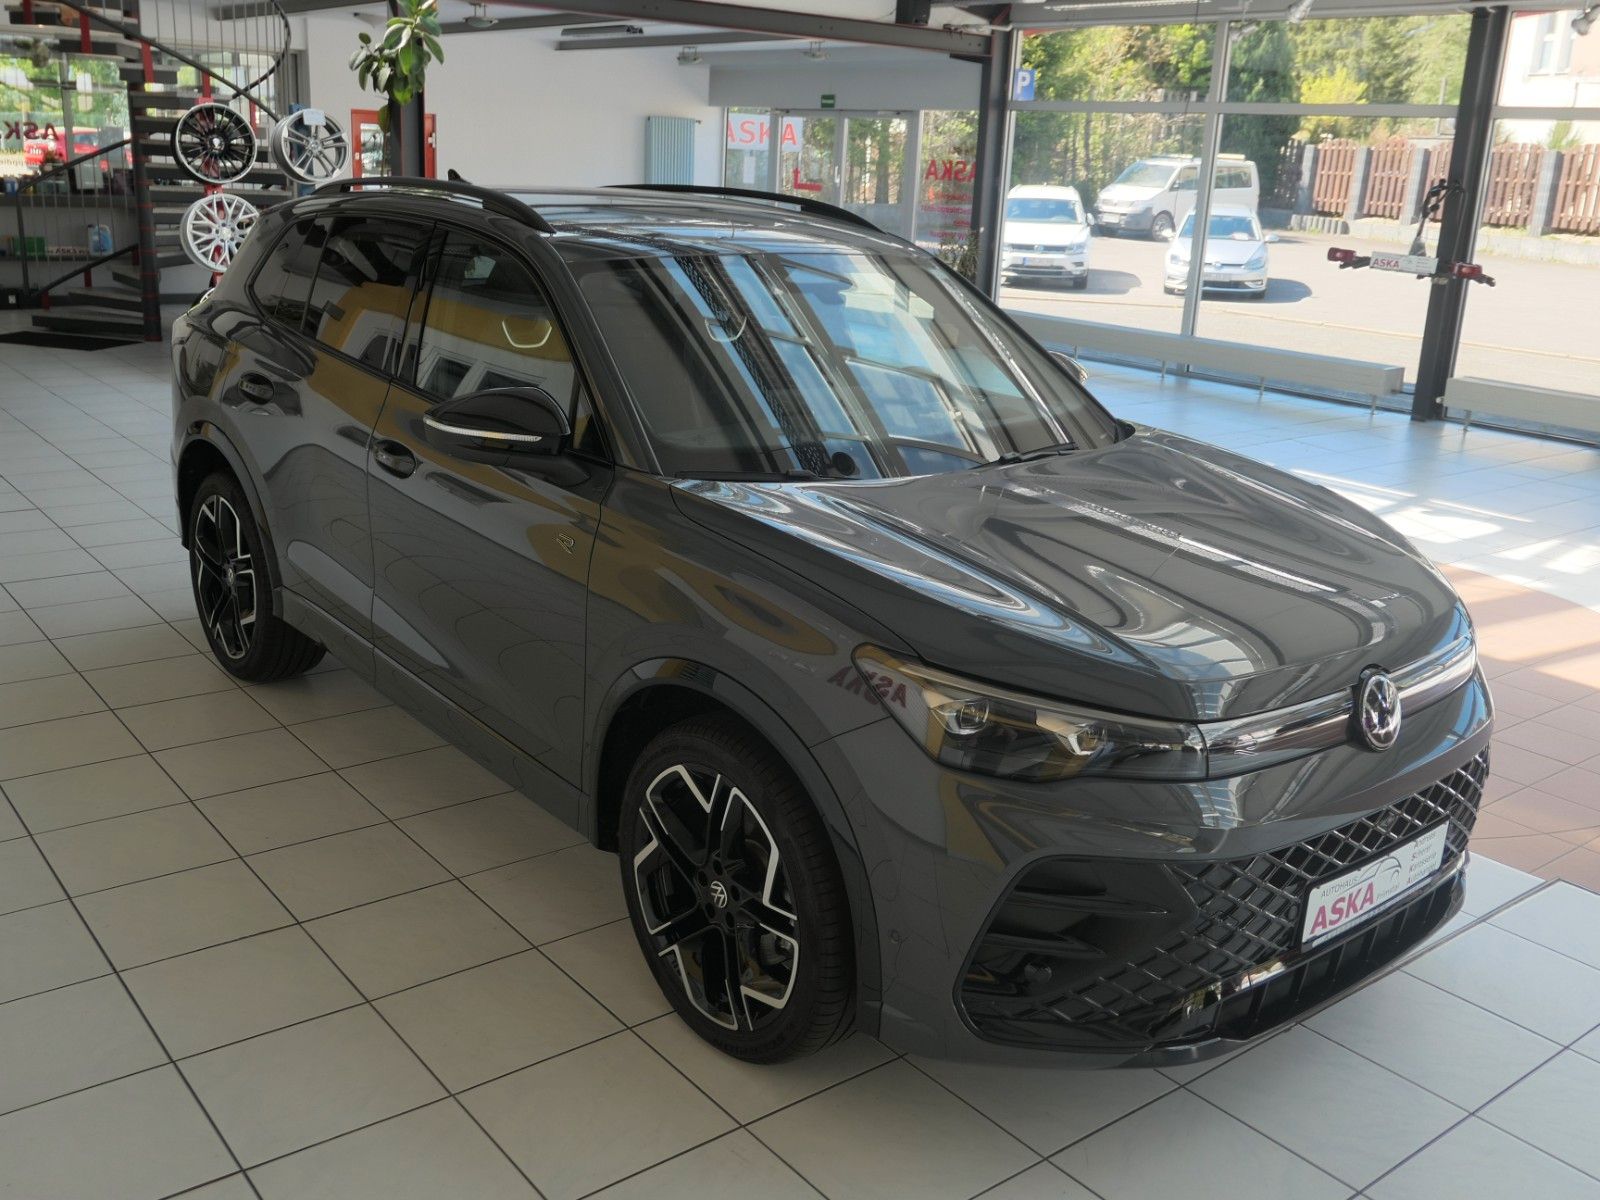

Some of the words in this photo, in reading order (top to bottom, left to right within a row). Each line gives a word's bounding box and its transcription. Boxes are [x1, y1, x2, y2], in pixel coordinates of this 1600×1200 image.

[1016, 70, 1031, 94] P
[1373, 258, 1400, 269] ASKA
[1309, 881, 1376, 935] ASKA
